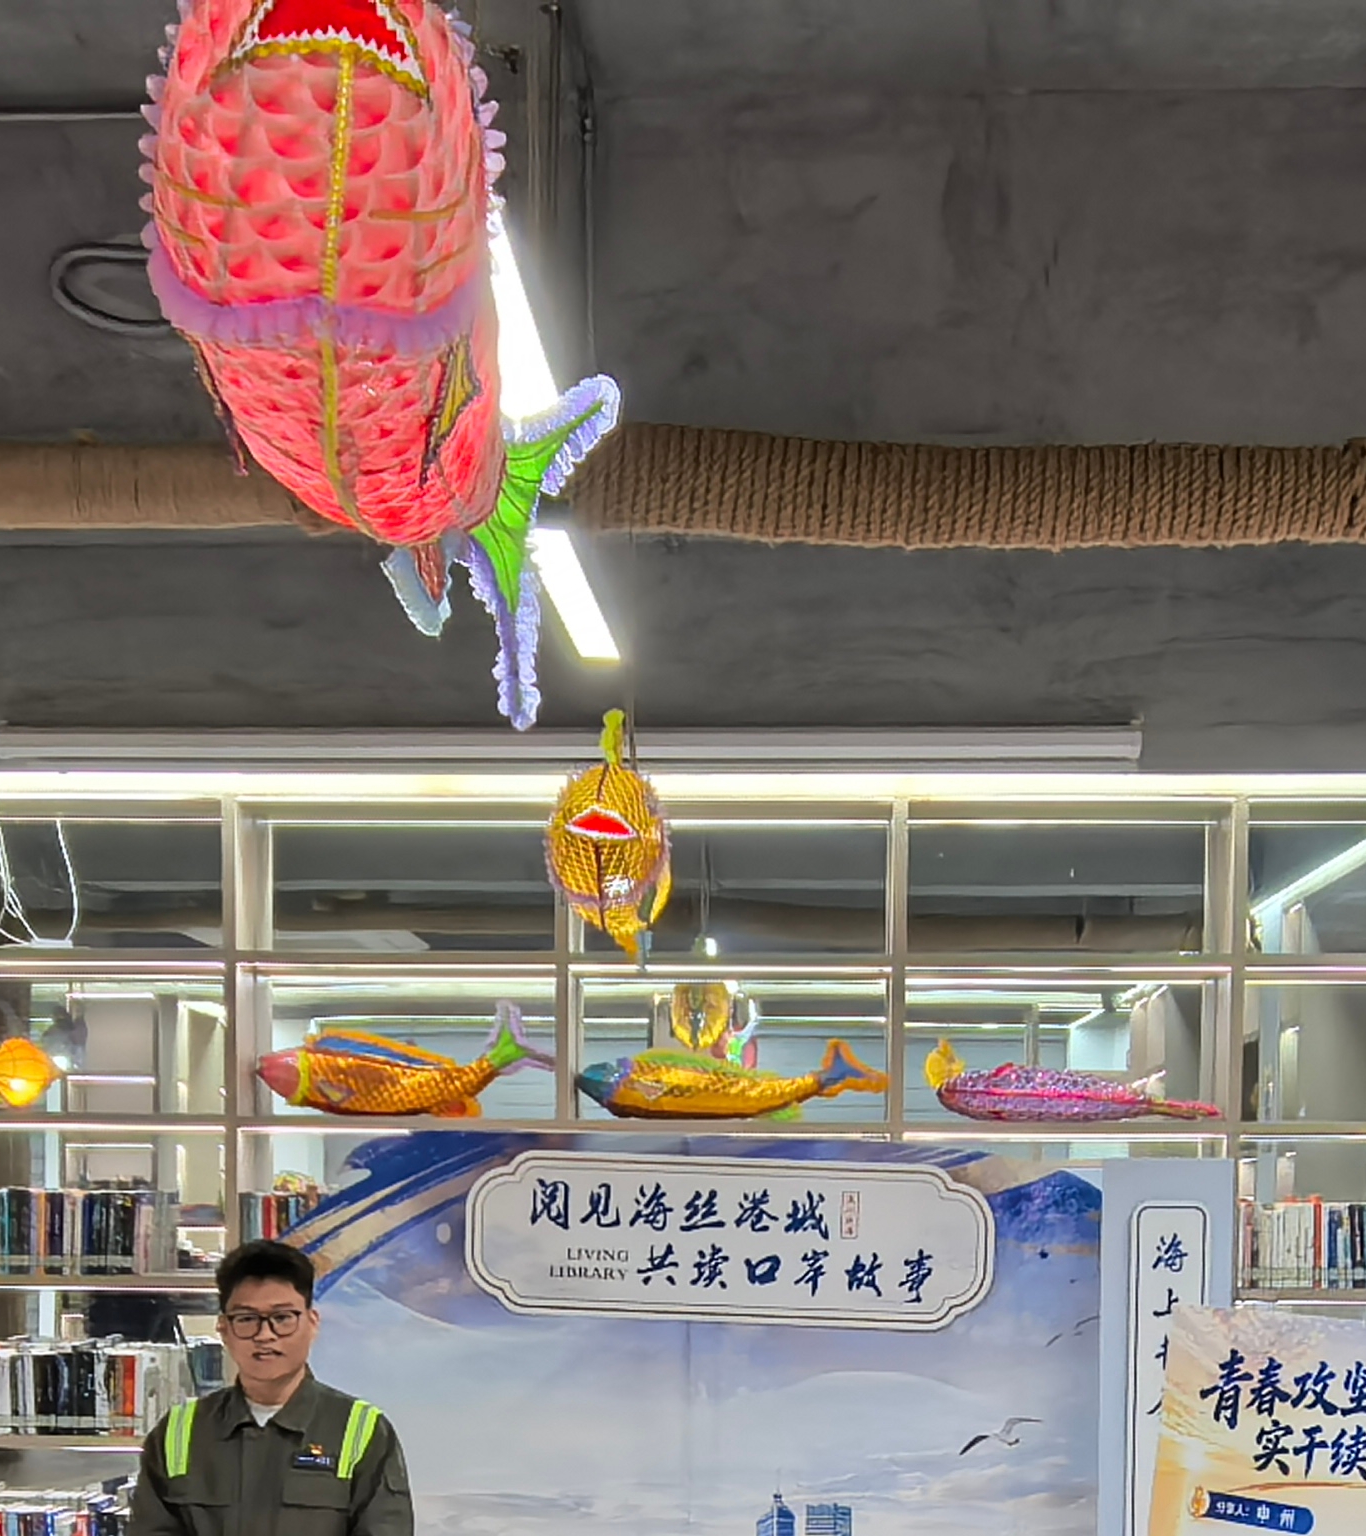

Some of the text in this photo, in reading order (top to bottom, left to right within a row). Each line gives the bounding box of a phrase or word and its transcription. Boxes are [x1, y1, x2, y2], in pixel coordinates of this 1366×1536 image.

[566, 1247, 629, 1262] LIVING
[549, 1264, 629, 1281] LIBRARY
[636, 1244, 934, 1304] 共读口岸故事
